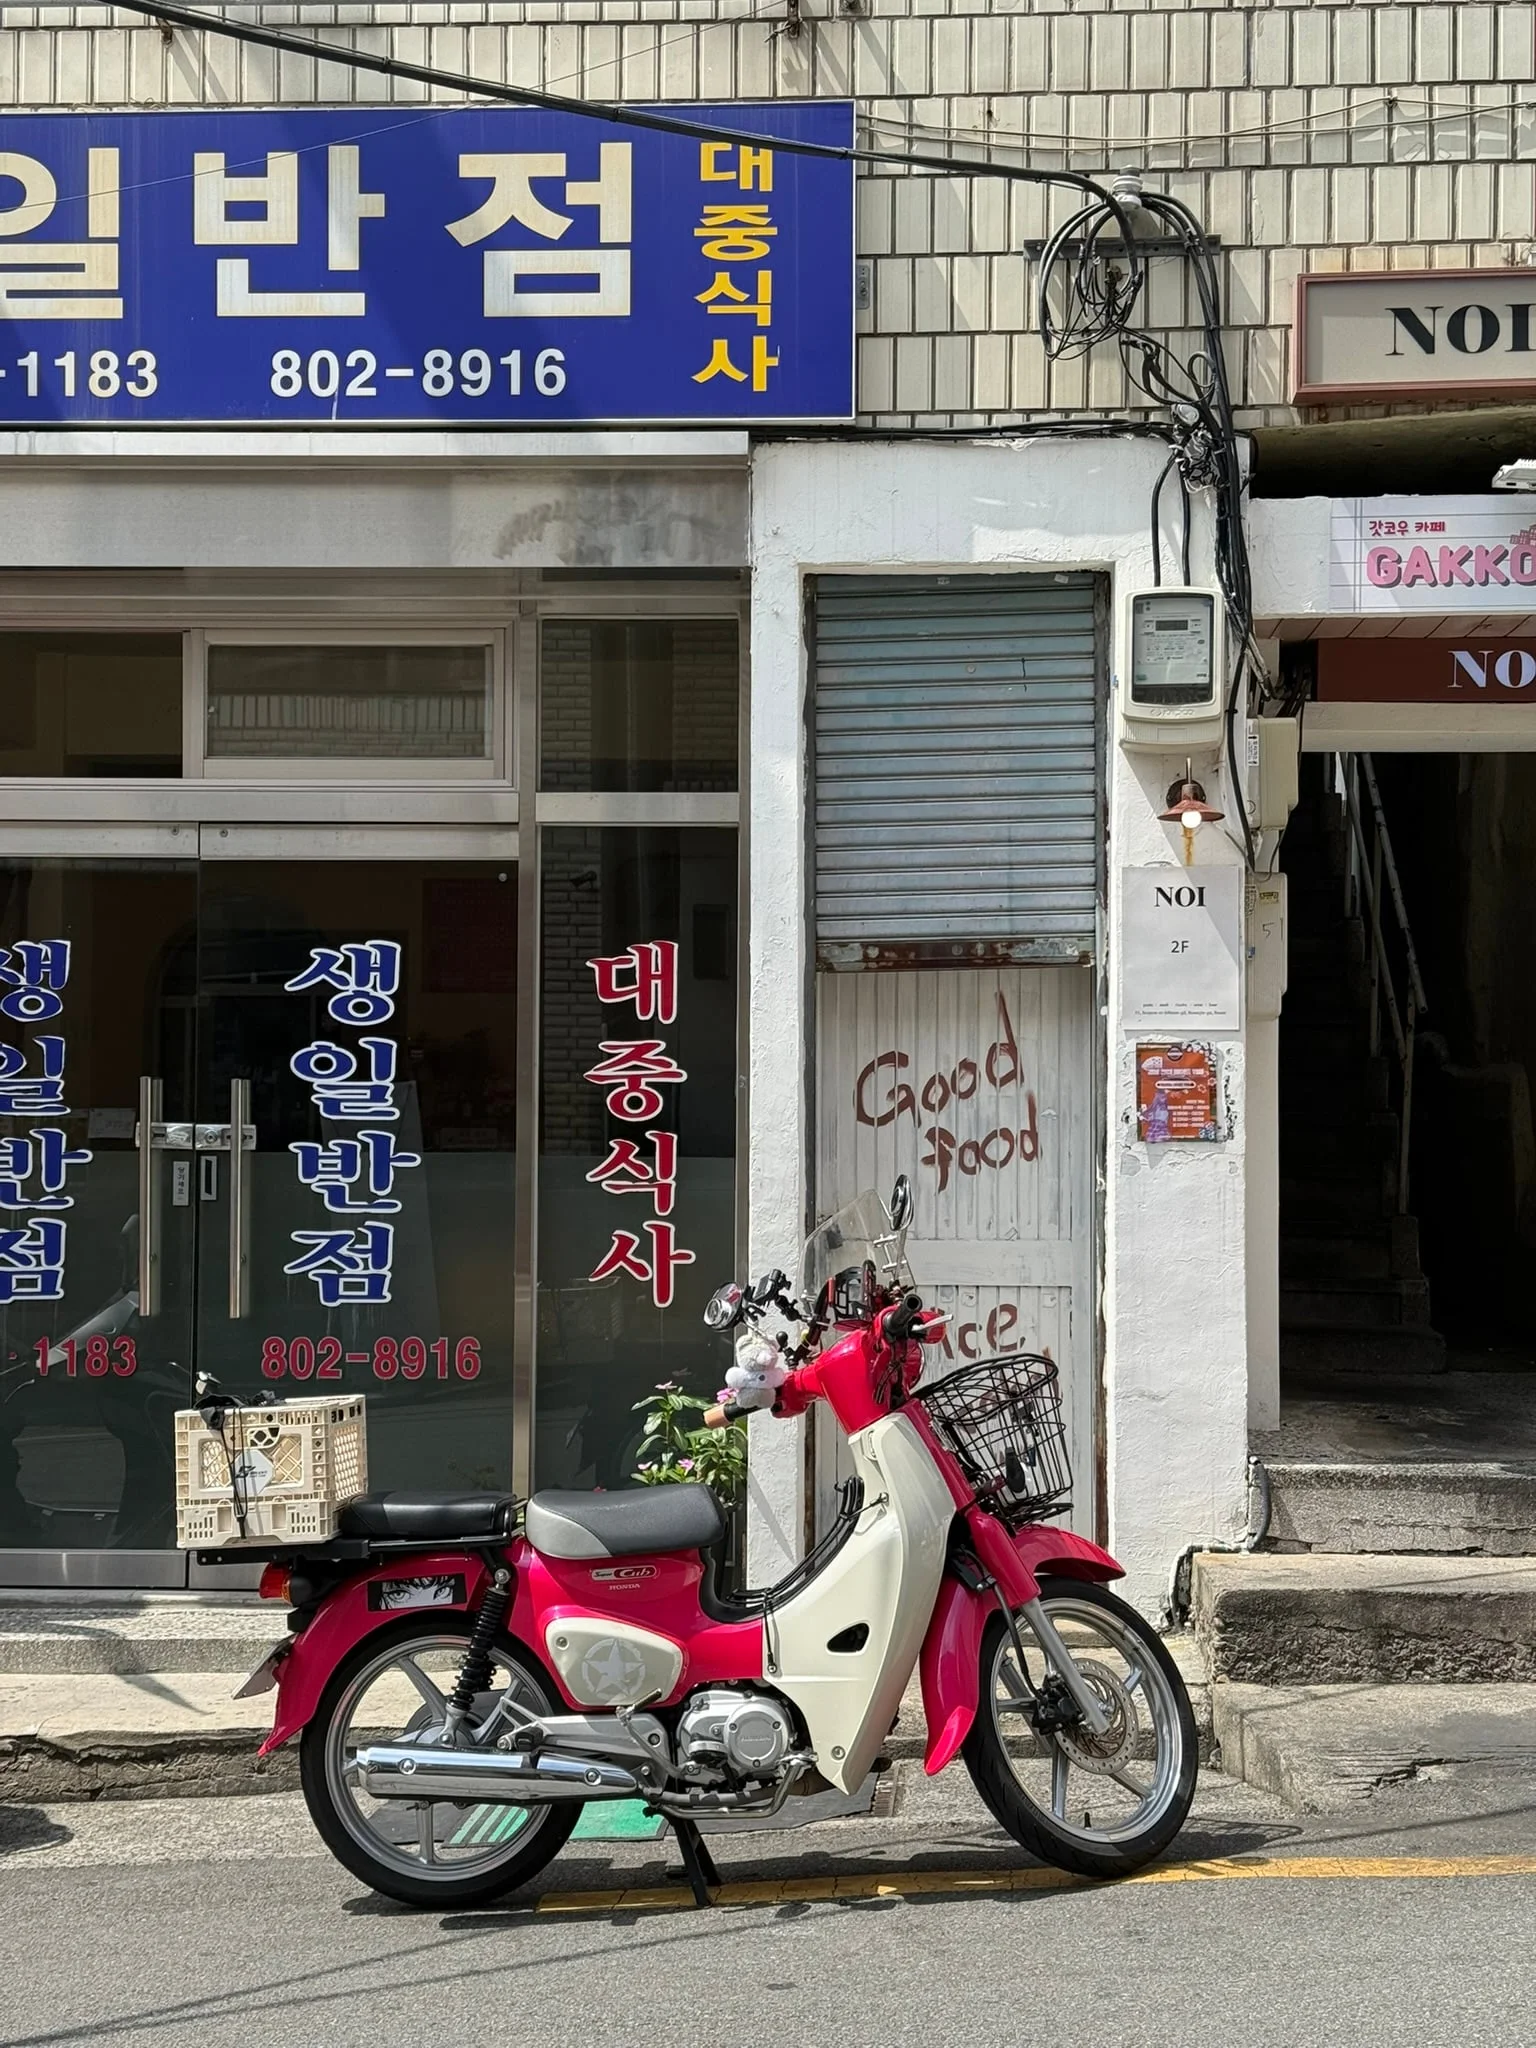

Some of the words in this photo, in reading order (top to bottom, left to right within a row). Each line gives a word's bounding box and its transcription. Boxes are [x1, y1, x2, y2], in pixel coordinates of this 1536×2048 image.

[0, 142, 632, 319] 일반점
[691, 142, 780, 392] 대중식사
[0, 350, 158, 398] 1183
[270, 348, 567, 397] 802-8916
[1369, 520, 1409, 536] 갓코우
[1415, 521, 1446, 533] 카페
[1367, 545, 1536, 588] GAKKO
[1448, 650, 1536, 688] NO
[1155, 886, 1206, 907] NOI
[1171, 940, 1189, 953] 2F
[853, 990, 1025, 1128] Good
[284, 940, 422, 1307] 생일반점
[583, 940, 696, 1309] 대중식사
[920, 1090, 1043, 1194] food
[261, 1336, 482, 1380] 802-8916
[608, 1583, 641, 1591] HONDA
